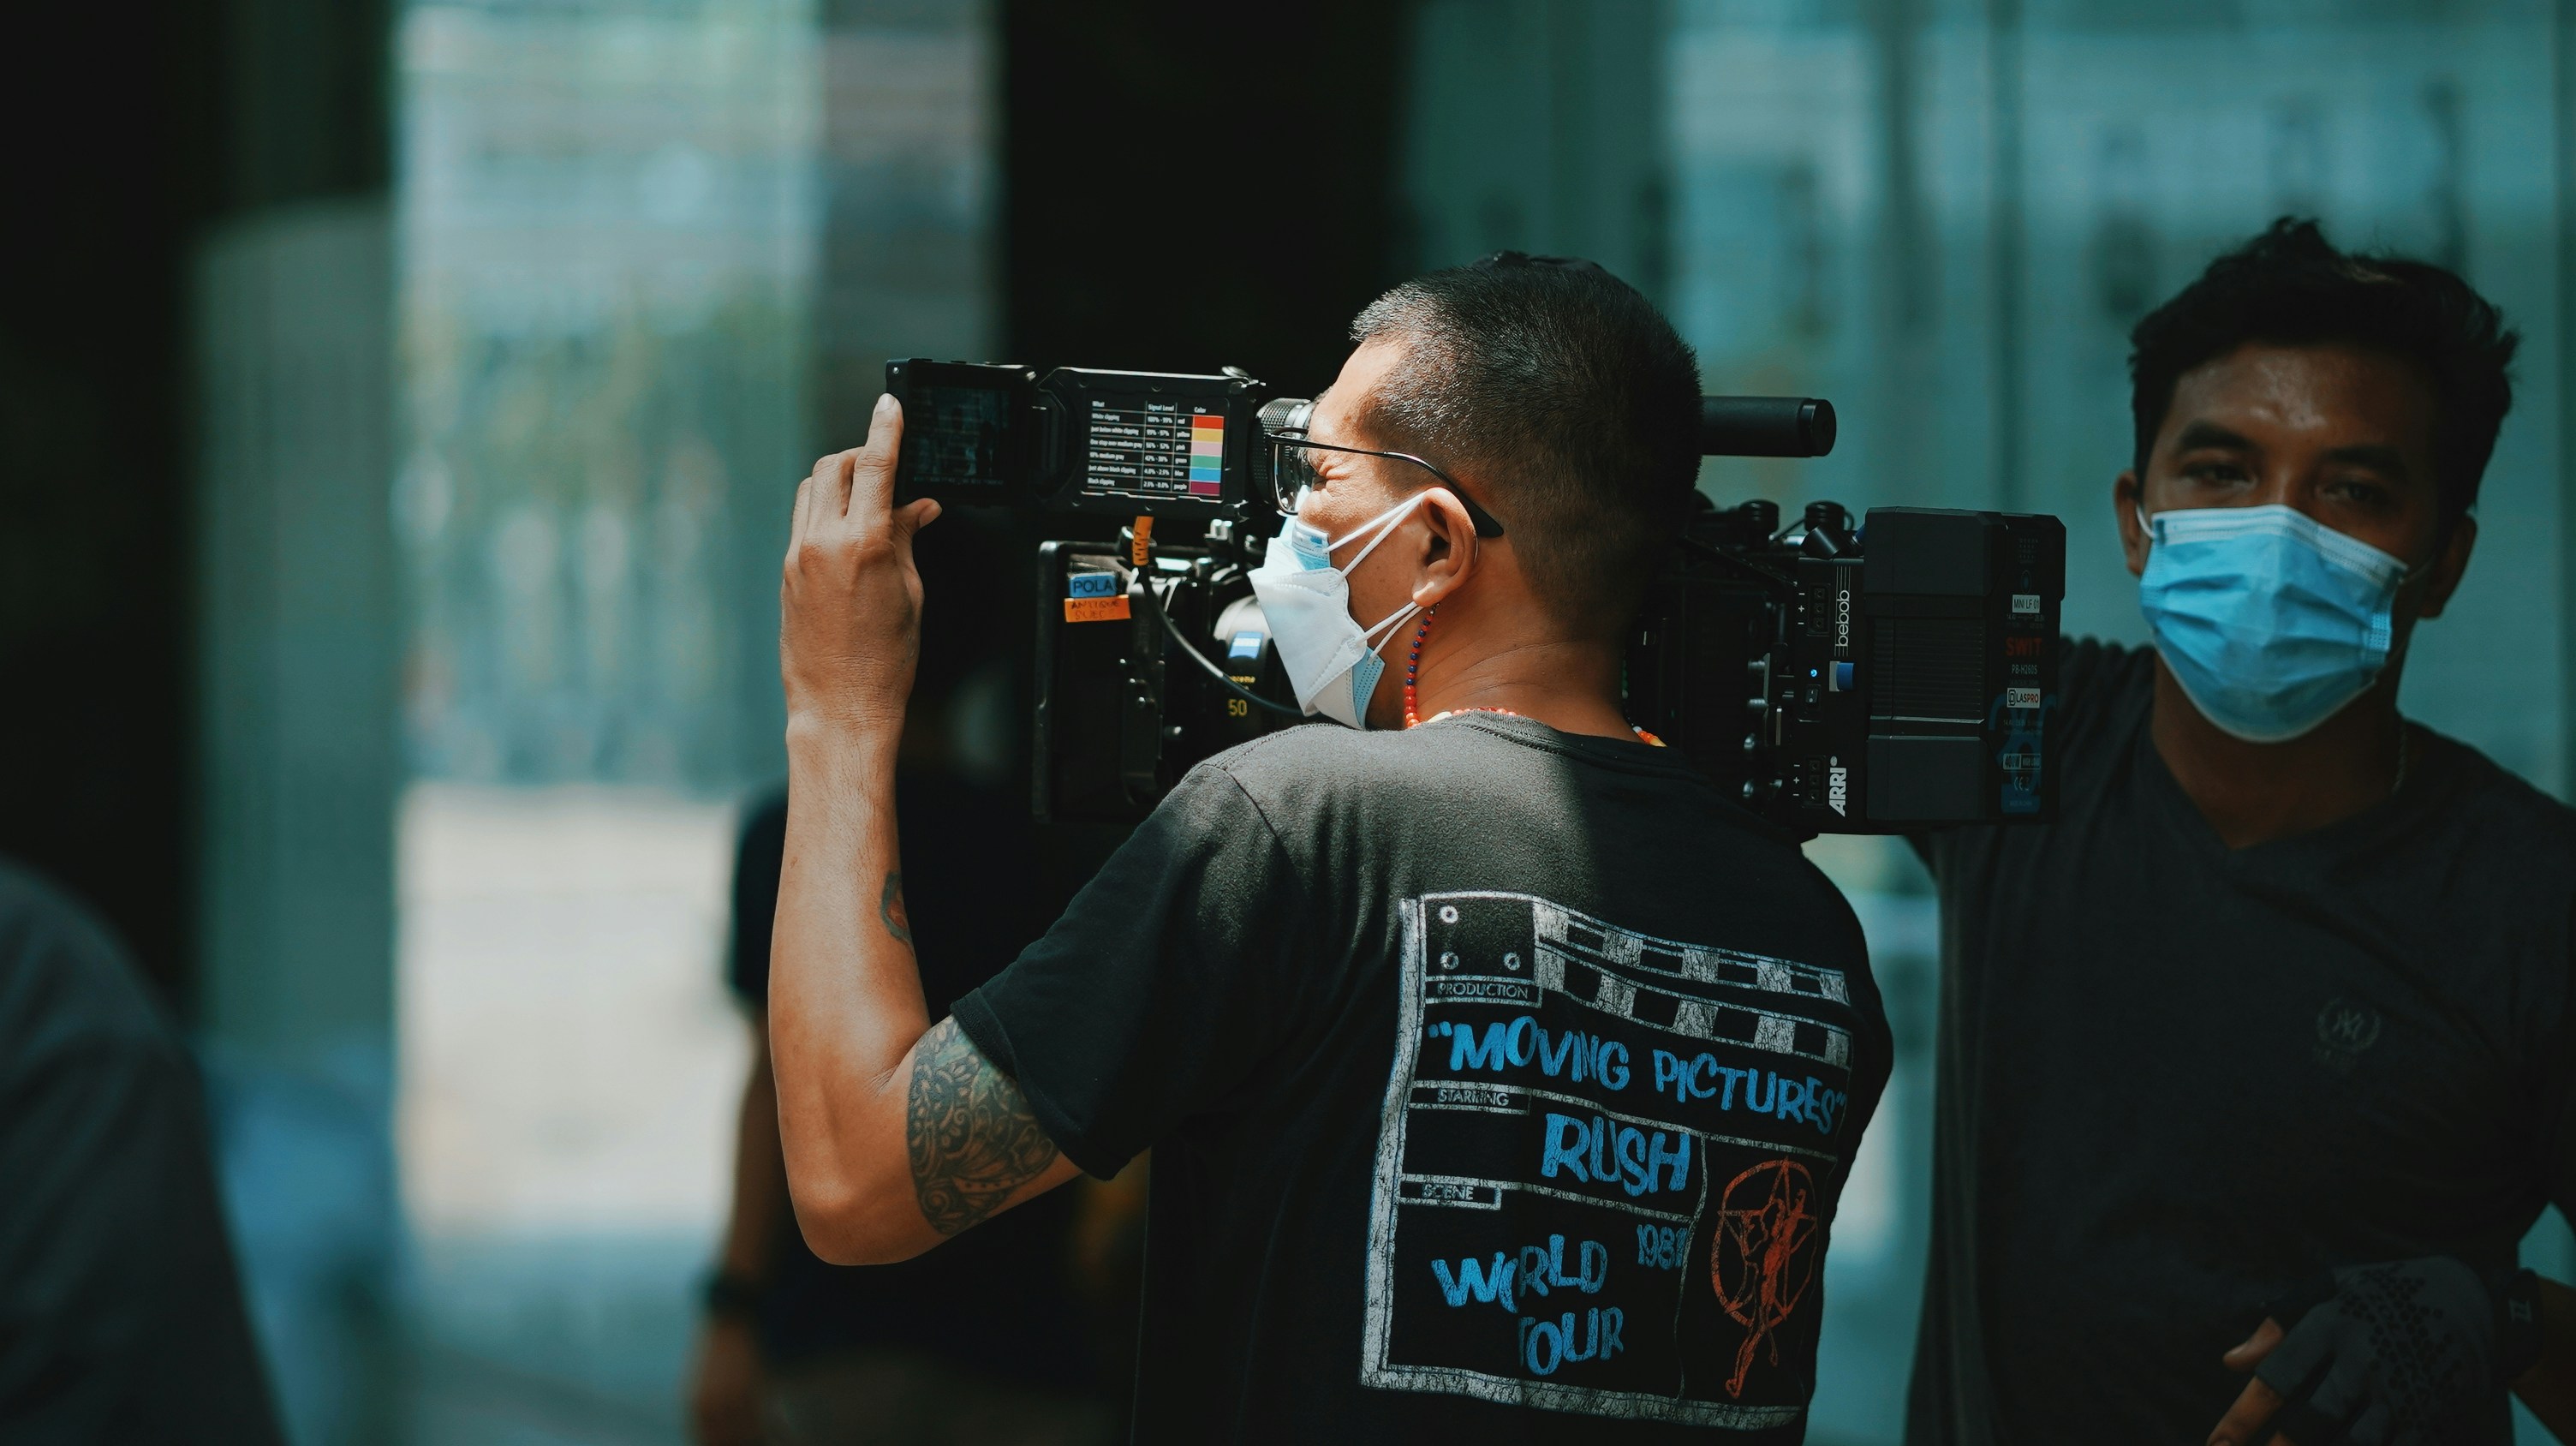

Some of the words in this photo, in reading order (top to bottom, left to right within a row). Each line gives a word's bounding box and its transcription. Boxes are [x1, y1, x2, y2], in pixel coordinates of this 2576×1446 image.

[1104, 413, 1120, 421] clipping
[1124, 427, 1139, 436] clipping
[1121, 466, 1136, 475] clipping
[1099, 478, 1115, 487] clipping
[1073, 579, 1114, 594] POLA
[2025, 599, 2033, 610] LF
[1834, 589, 1850, 647] bebob
[2005, 636, 2042, 657] SWIT
[2011, 664, 2038, 675] PB-H260S
[1227, 699, 1248, 716] 50
[1828, 767, 1847, 817] ARRI
[1437, 983, 1529, 999] PRODUCTION
[1541, 1113, 1691, 1197] RUSH
[1421, 1182, 1475, 1200] SCENE
[1637, 1223, 1688, 1270] 1981
[1517, 1306, 1625, 1377] TOUR
